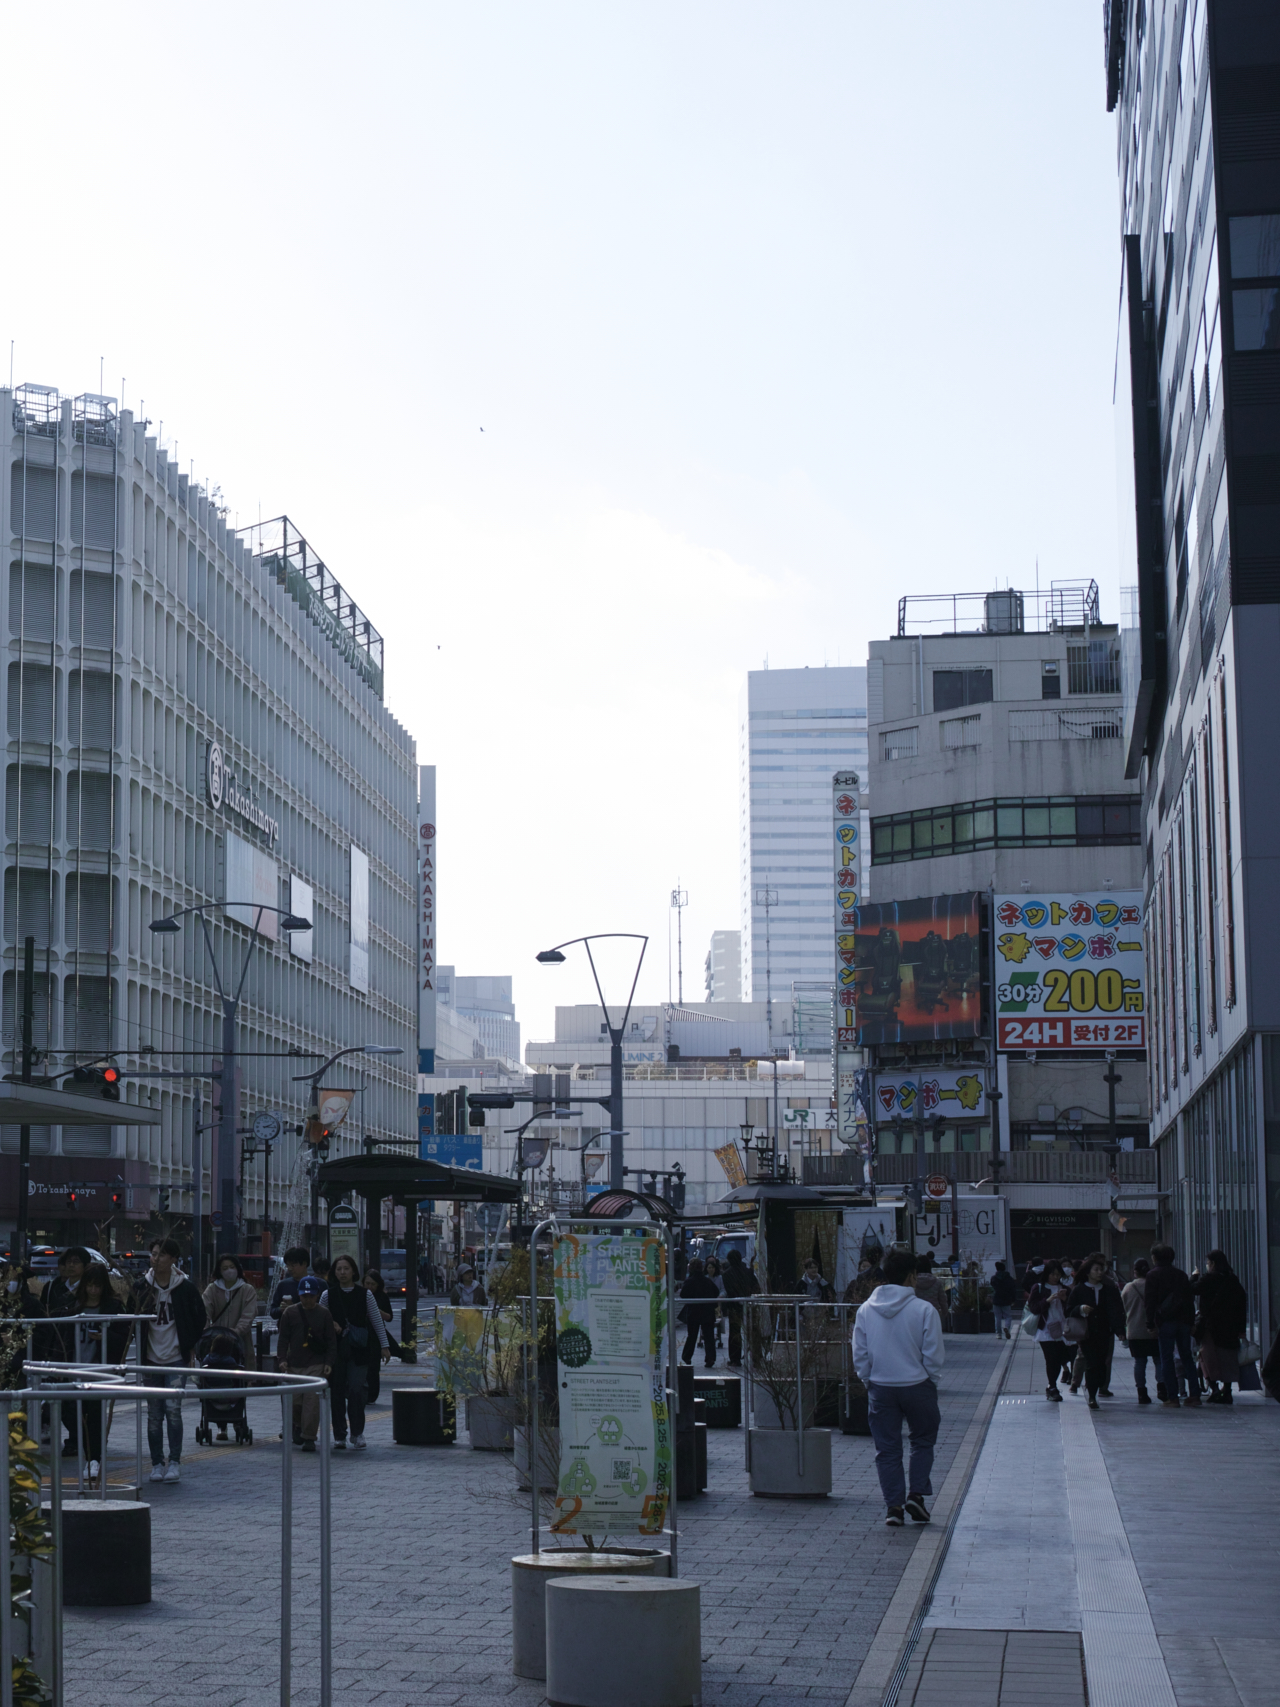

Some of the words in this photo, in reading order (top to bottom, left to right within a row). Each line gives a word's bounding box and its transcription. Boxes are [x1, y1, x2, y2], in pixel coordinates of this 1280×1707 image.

[223, 764, 280, 848] Takashimaya
[422, 844, 433, 990] TAKASHIMAYA
[997, 900, 1140, 928] ネットカフェ
[1032, 933, 1143, 961] マンボー
[998, 982, 1041, 1003] 30分
[1004, 1020, 1064, 1045] 24H
[1073, 1025, 1110, 1042] 受付
[1114, 1024, 1139, 1042] 2F
[621, 1050, 655, 1062] UMINE
[784, 1109, 809, 1123] JR
[37, 1184, 96, 1197] Takashmaya
[929, 1183, 946, 1191] 消火栓
[1036, 1215, 1077, 1223] BIGVISION
[597, 1245, 645, 1258] STREET
[597, 1259, 647, 1272] PLANTS
[596, 1272, 650, 1286] PROJECT
